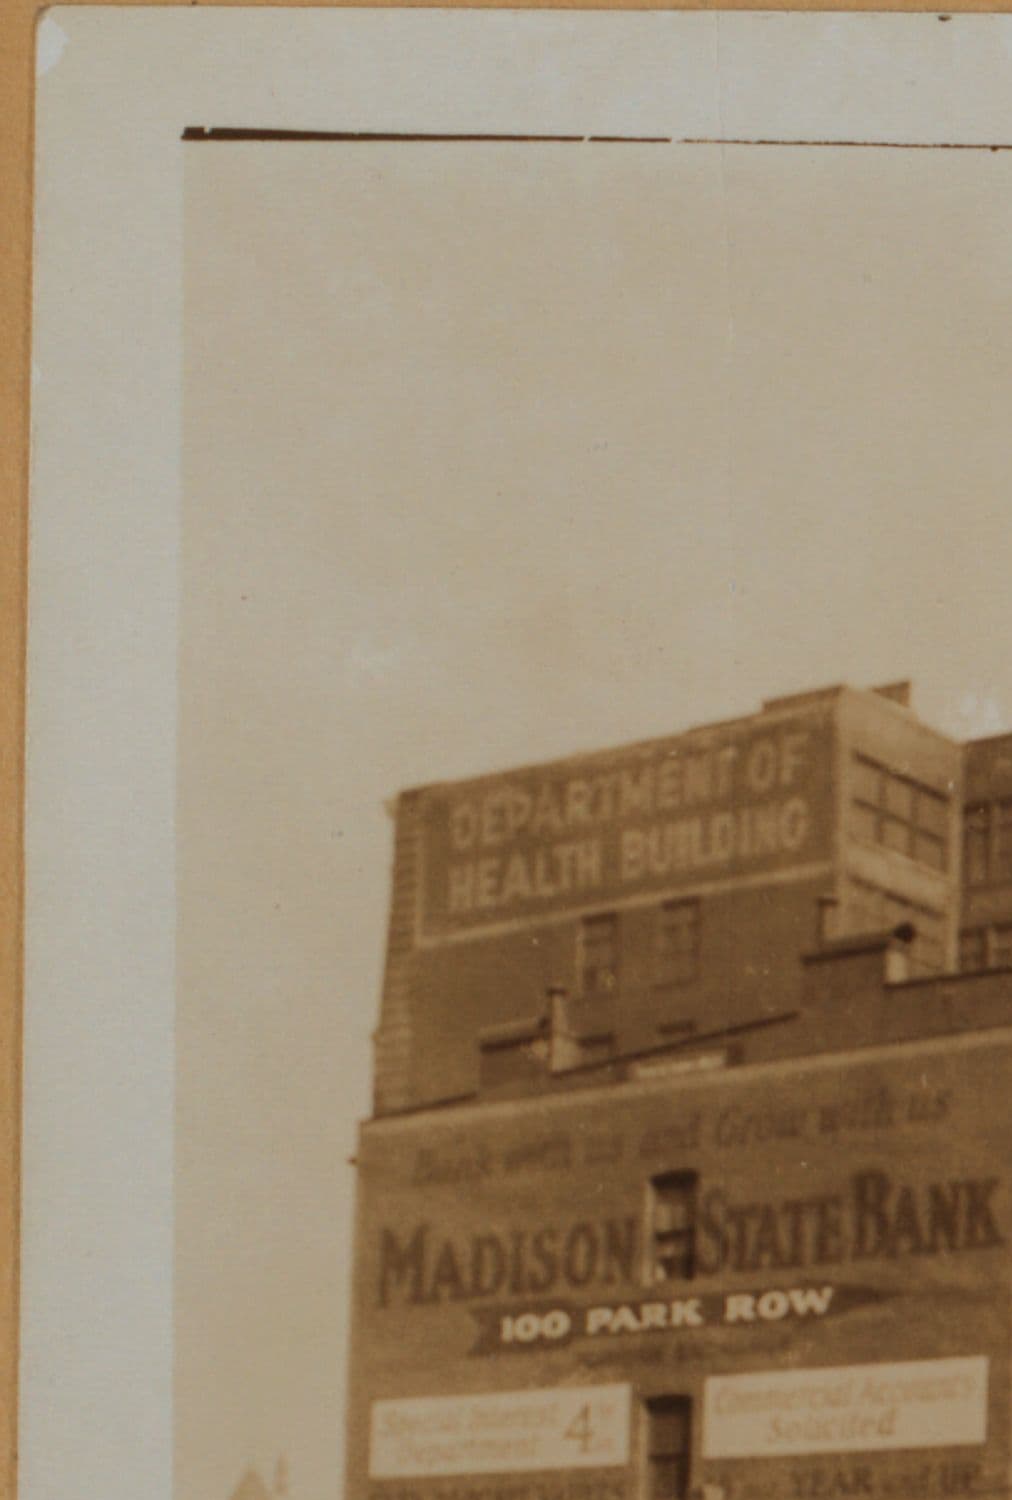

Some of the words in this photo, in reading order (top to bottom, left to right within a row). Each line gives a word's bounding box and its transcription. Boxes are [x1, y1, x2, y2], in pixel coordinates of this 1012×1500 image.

[449, 746, 738, 850] DEPARTMENT
[745, 733, 809, 792] OF
[446, 837, 602, 913] HEALTH
[620, 796, 809, 881] BUILDING
[377, 1216, 641, 1307] MADISON
[694, 1187, 843, 1278] STATE
[849, 1168, 1006, 1257] BANK
[501, 1310, 571, 1343] 100
[586, 1298, 702, 1336] PARK
[723, 1286, 833, 1323] ROW
[563, 1401, 595, 1454] 4
